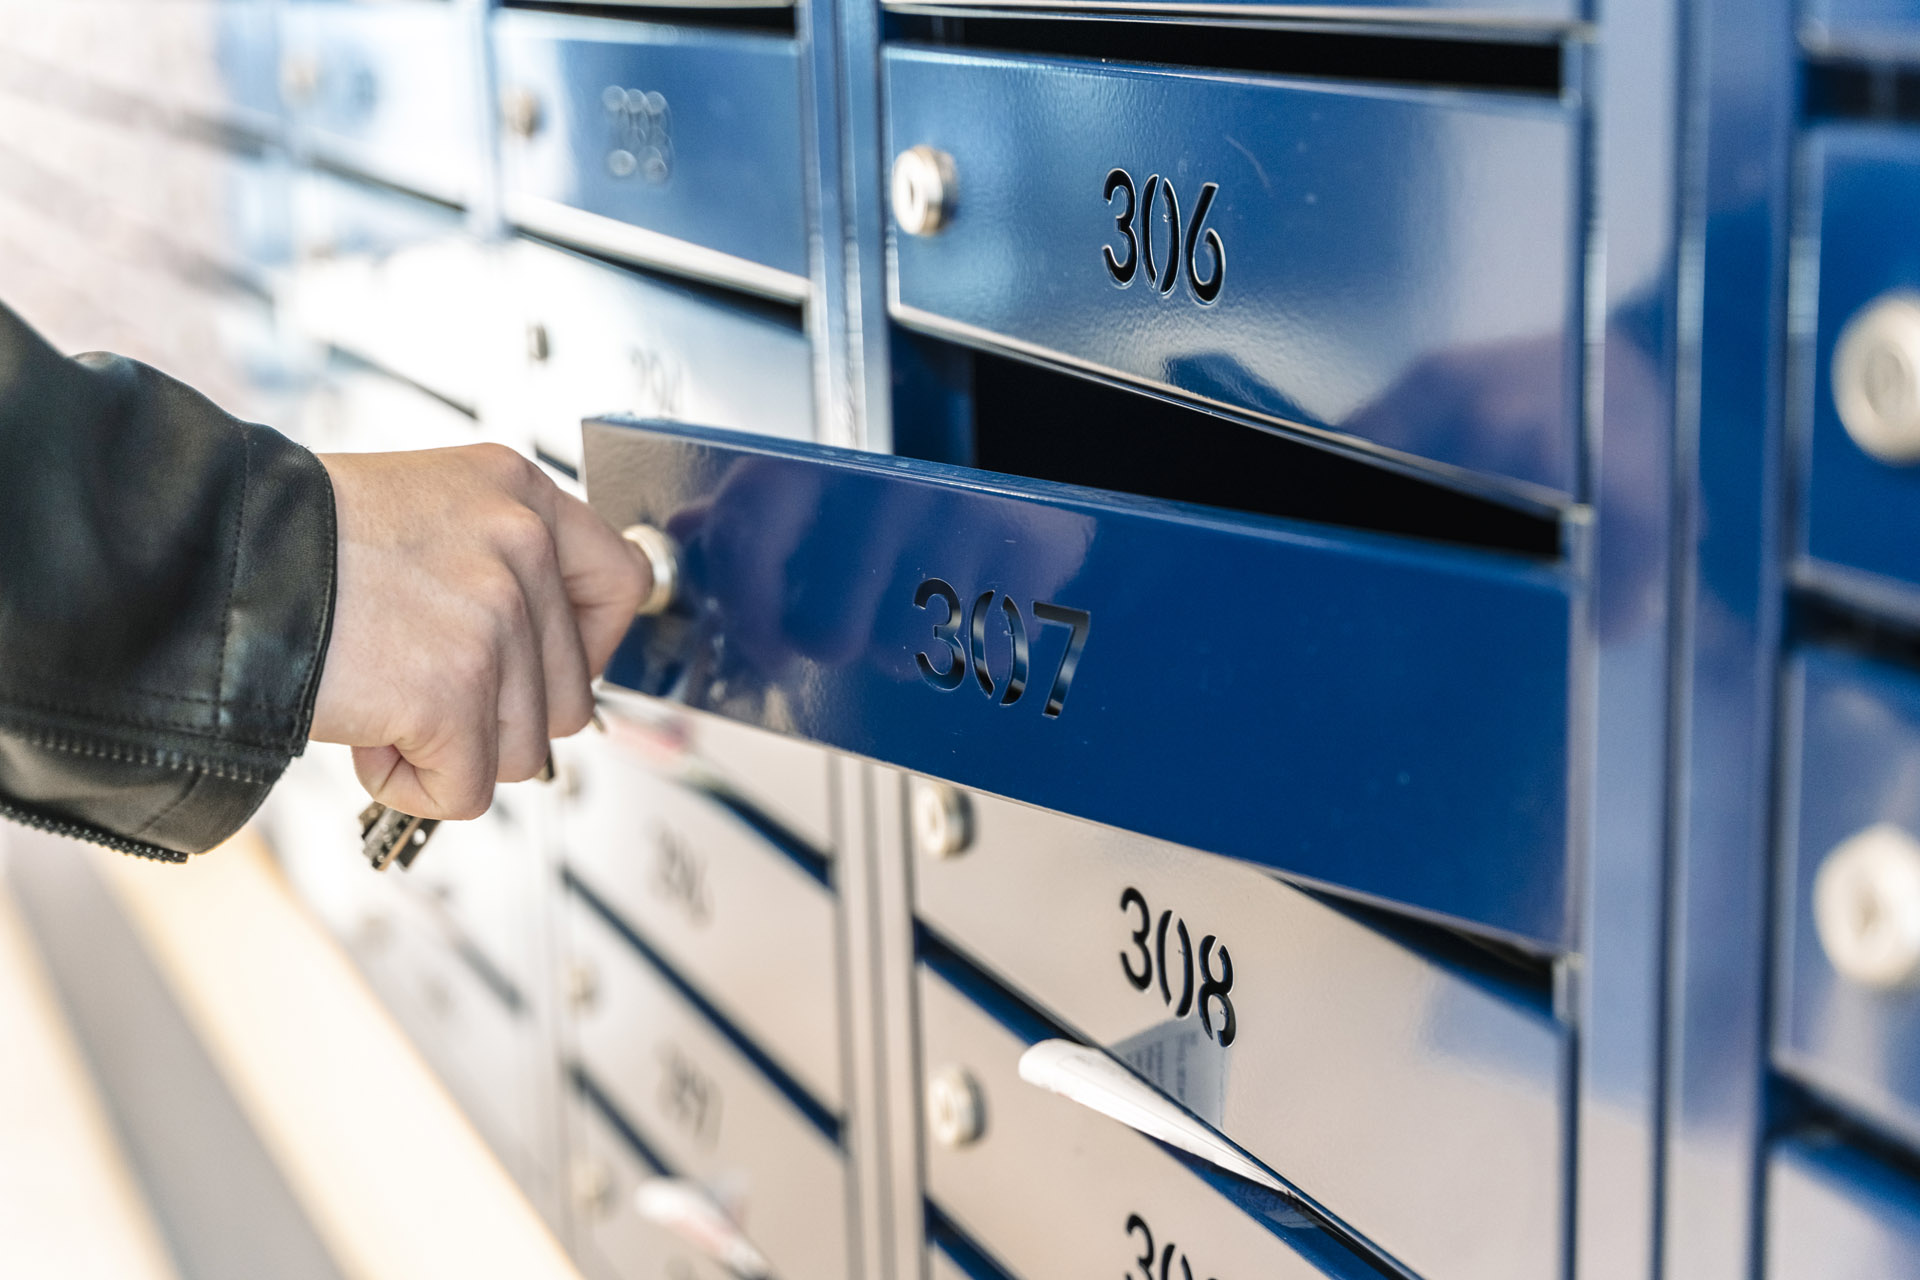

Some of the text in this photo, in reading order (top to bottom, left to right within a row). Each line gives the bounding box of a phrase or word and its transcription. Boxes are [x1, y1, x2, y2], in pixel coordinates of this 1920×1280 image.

[1101, 167, 1227, 307] 306
[912, 577, 1092, 720] 307
[1118, 886, 1237, 1047] 308
